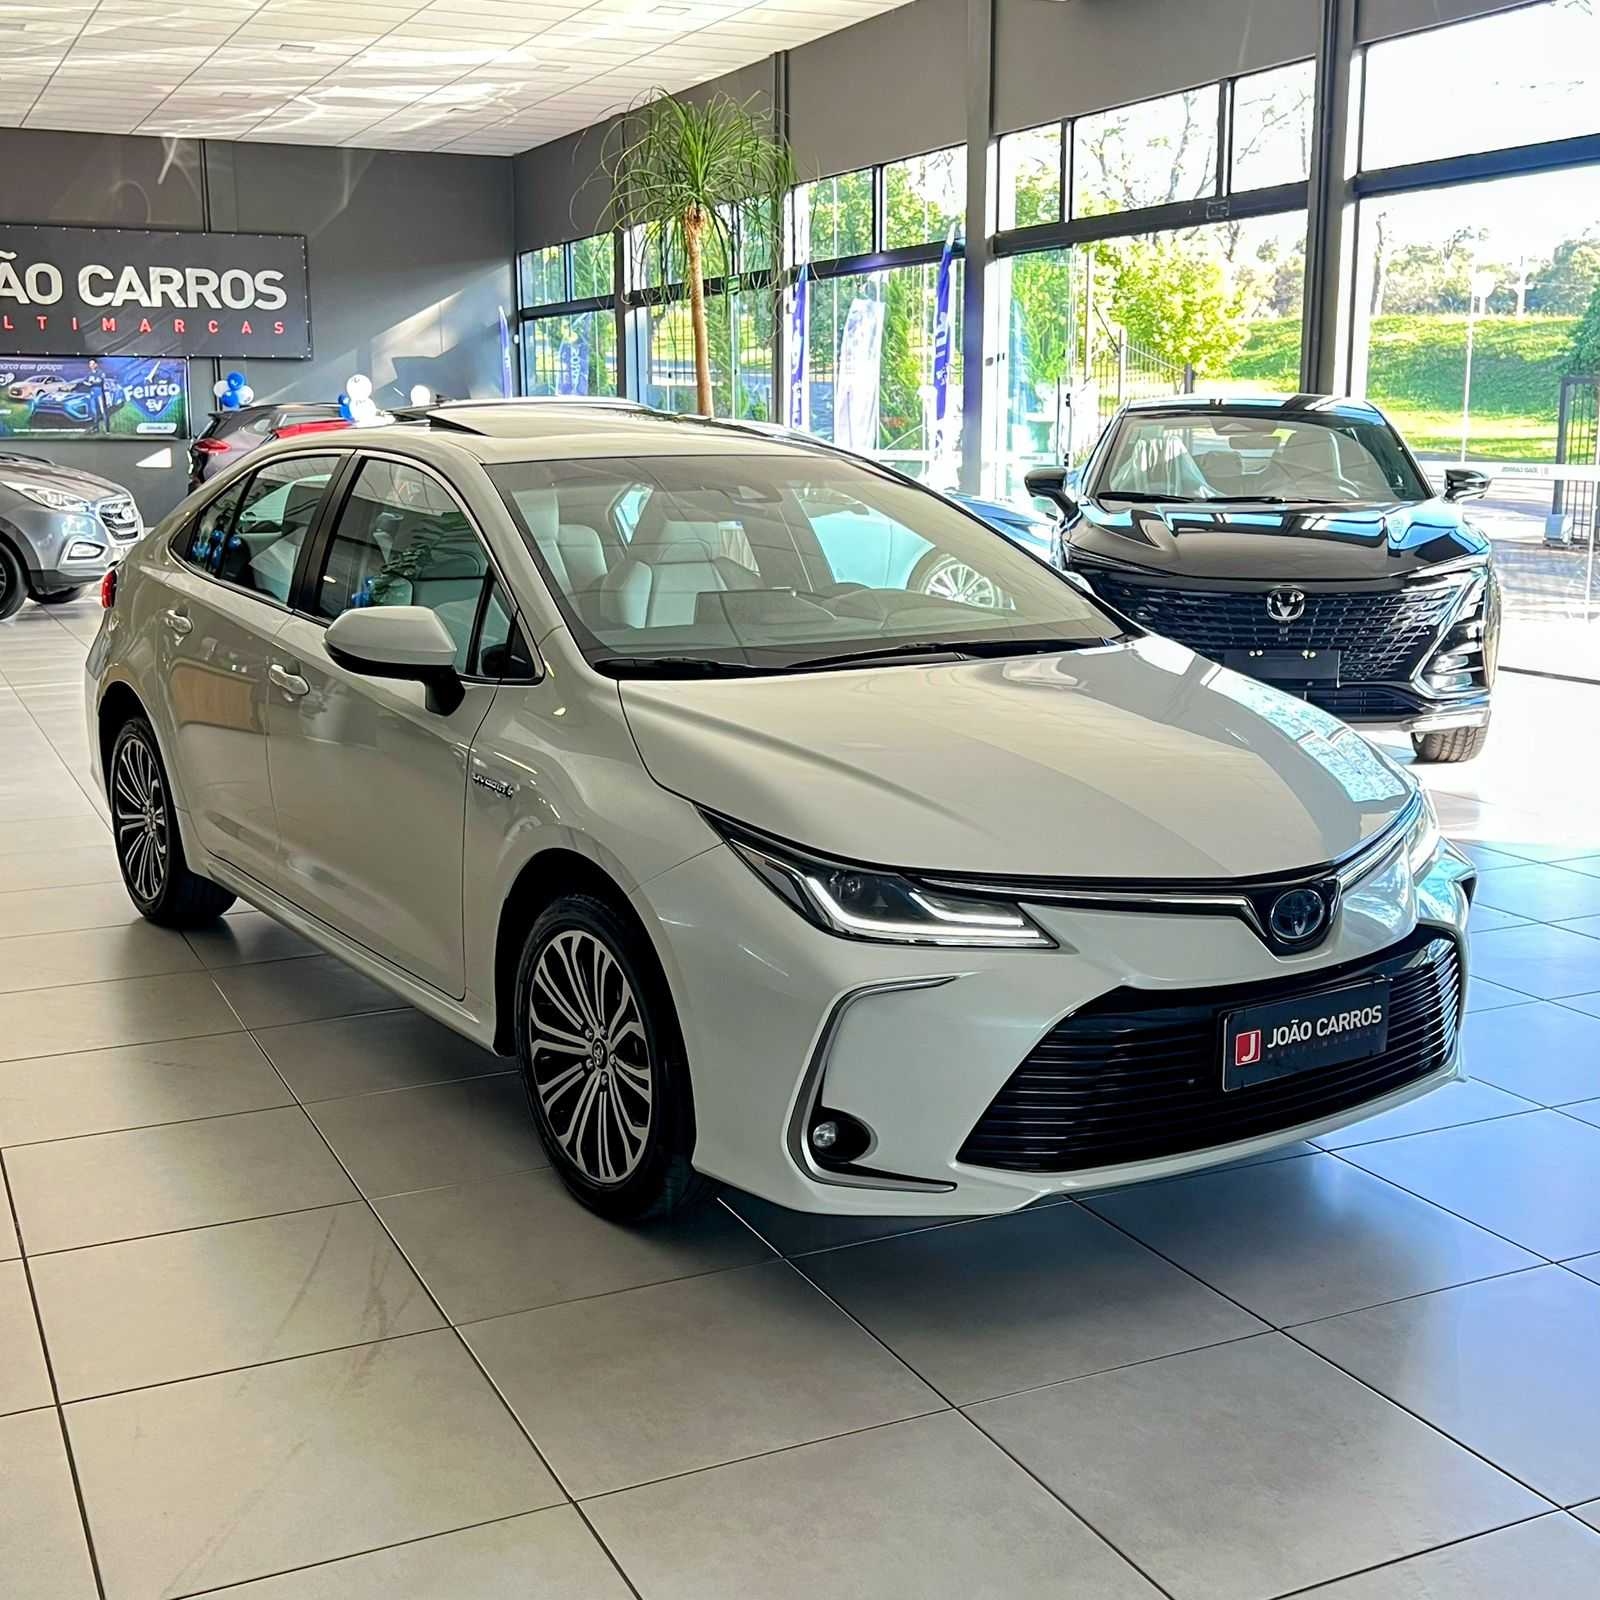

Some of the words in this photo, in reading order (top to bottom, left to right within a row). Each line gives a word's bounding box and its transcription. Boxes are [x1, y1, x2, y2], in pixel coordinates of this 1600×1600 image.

[78, 264, 287, 310] CARROS
[3, 314, 285, 335] LTIMARCAS
[123, 380, 180, 402] Feirão
[1267, 1019, 1312, 1049] JOÃO
[1316, 1005, 1382, 1037] CARROS
[1241, 1033, 1256, 1062] J
